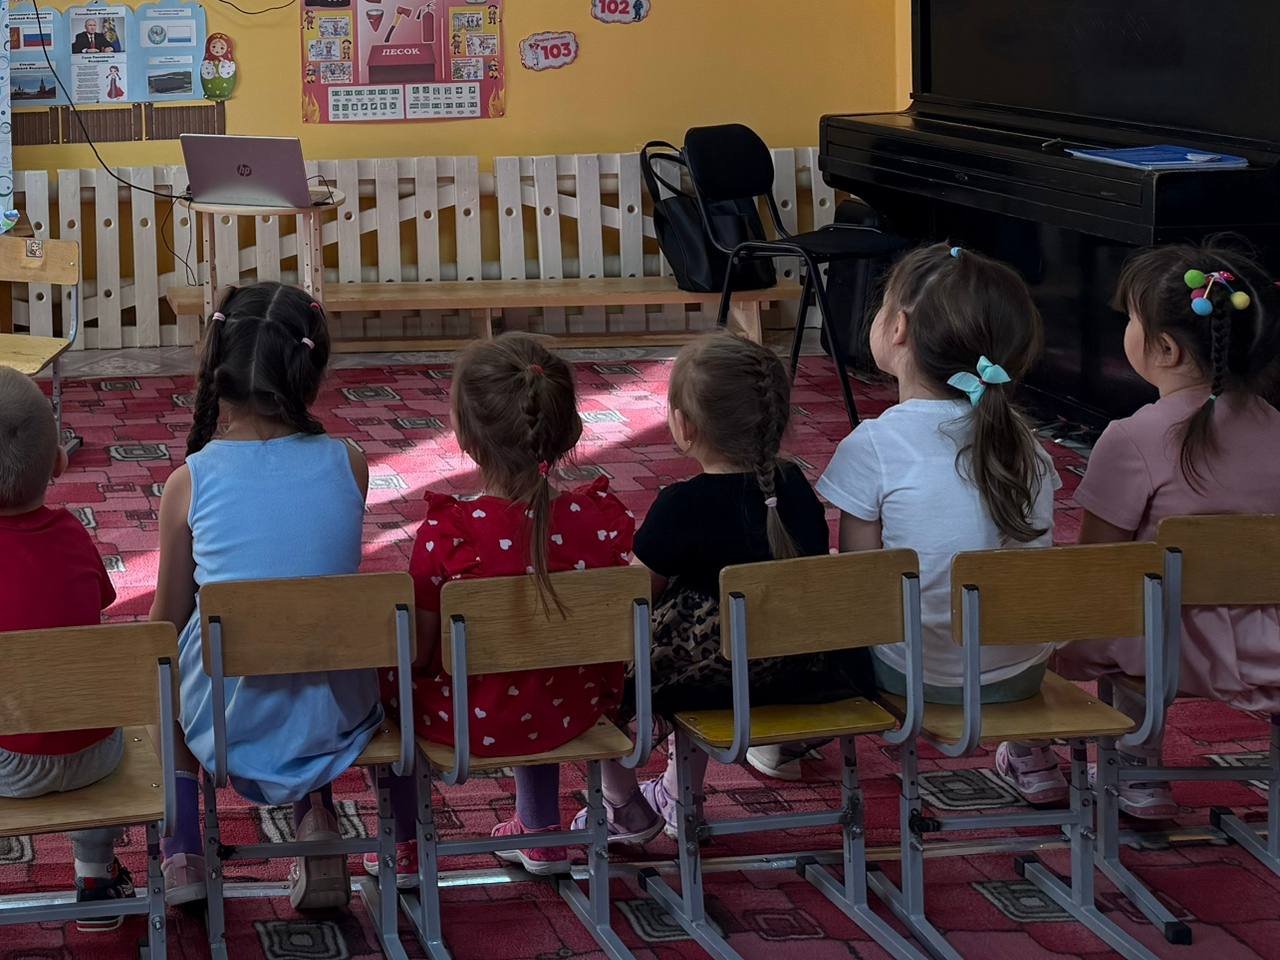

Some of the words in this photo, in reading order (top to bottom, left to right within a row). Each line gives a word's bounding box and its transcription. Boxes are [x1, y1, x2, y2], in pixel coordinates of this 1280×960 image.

[598, 0, 630, 15] 102
[382, 48, 420, 56] ПЕСОК
[540, 43, 572, 60] 103
[238, 164, 252, 177] hp
